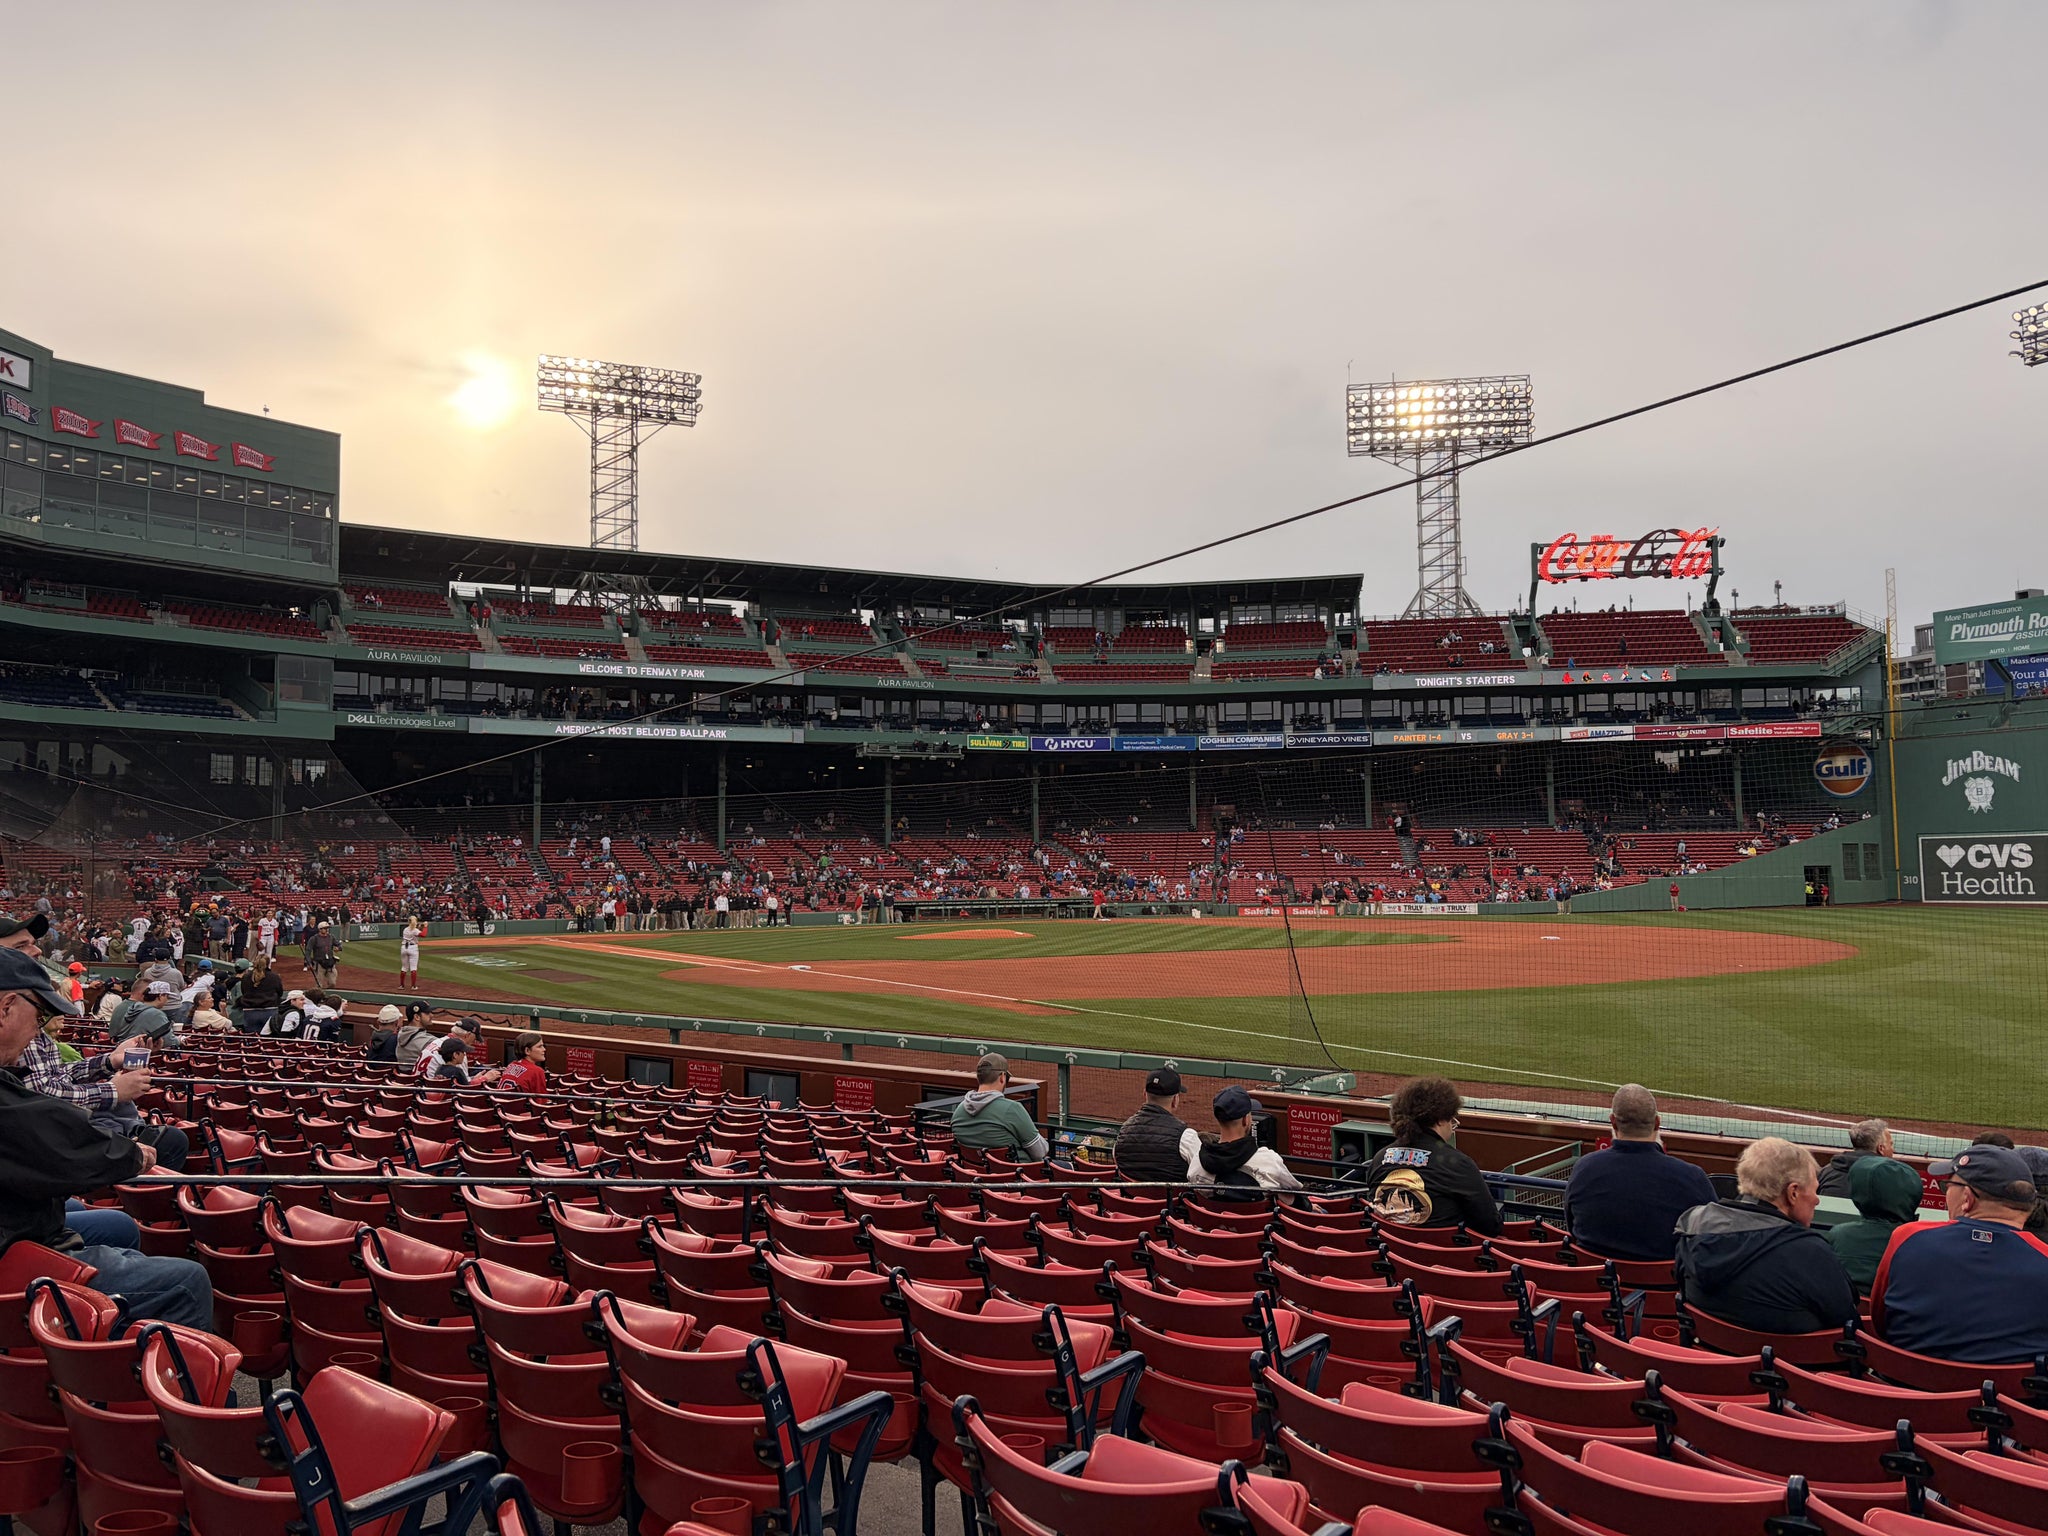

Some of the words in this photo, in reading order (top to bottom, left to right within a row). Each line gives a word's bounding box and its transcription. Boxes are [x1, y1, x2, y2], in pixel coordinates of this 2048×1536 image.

[1944, 614, 1961, 622] More
[1978, 609, 1991, 617] Just
[1991, 606, 2023, 615] Insurance.
[1950, 615, 2024, 640] Plymouth
[400, 653, 441, 663] PAVILION
[579, 664, 623, 674] WELCOME
[626, 666, 638, 675] TO
[640, 666, 678, 677] FENWAY
[681, 669, 705, 678] PARK
[2010, 671, 2036, 680] Your
[902, 680, 935, 688] PAVILION
[1415, 676, 1463, 686] TONIGHT'S
[1466, 675, 1516, 685] STARTERS
[2016, 681, 2041, 689] care
[375, 715, 432, 728] Technologies
[433, 718, 456, 728] Level
[555, 725, 605, 734] AMERICA'S
[608, 727, 633, 736] MOST
[636, 727, 678, 737] BELOVED
[680, 729, 727, 738] BALLPARK
[1730, 727, 1773, 735] Safelite
[1011, 740, 1026, 748] TIRE
[1061, 739, 1094, 748] HYCU
[1393, 734, 1427, 742] PAINTER
[1815, 758, 1867, 777] Gulf
[1967, 843, 2033, 869] CVS
[1903, 876, 1919, 884] 310
[1940, 871, 2036, 895] Health
[303, 1023, 320, 1040] 10
[836, 1079, 872, 1090] CAUTION!
[1290, 1109, 1339, 1123] CAUTION!
[1293, 1141, 1316, 1149] OBJECTS
[1267, 1330, 1273, 1342] F
[1061, 1350, 1070, 1362] G
[771, 1394, 782, 1410] H
[308, 1466, 322, 1487] J
